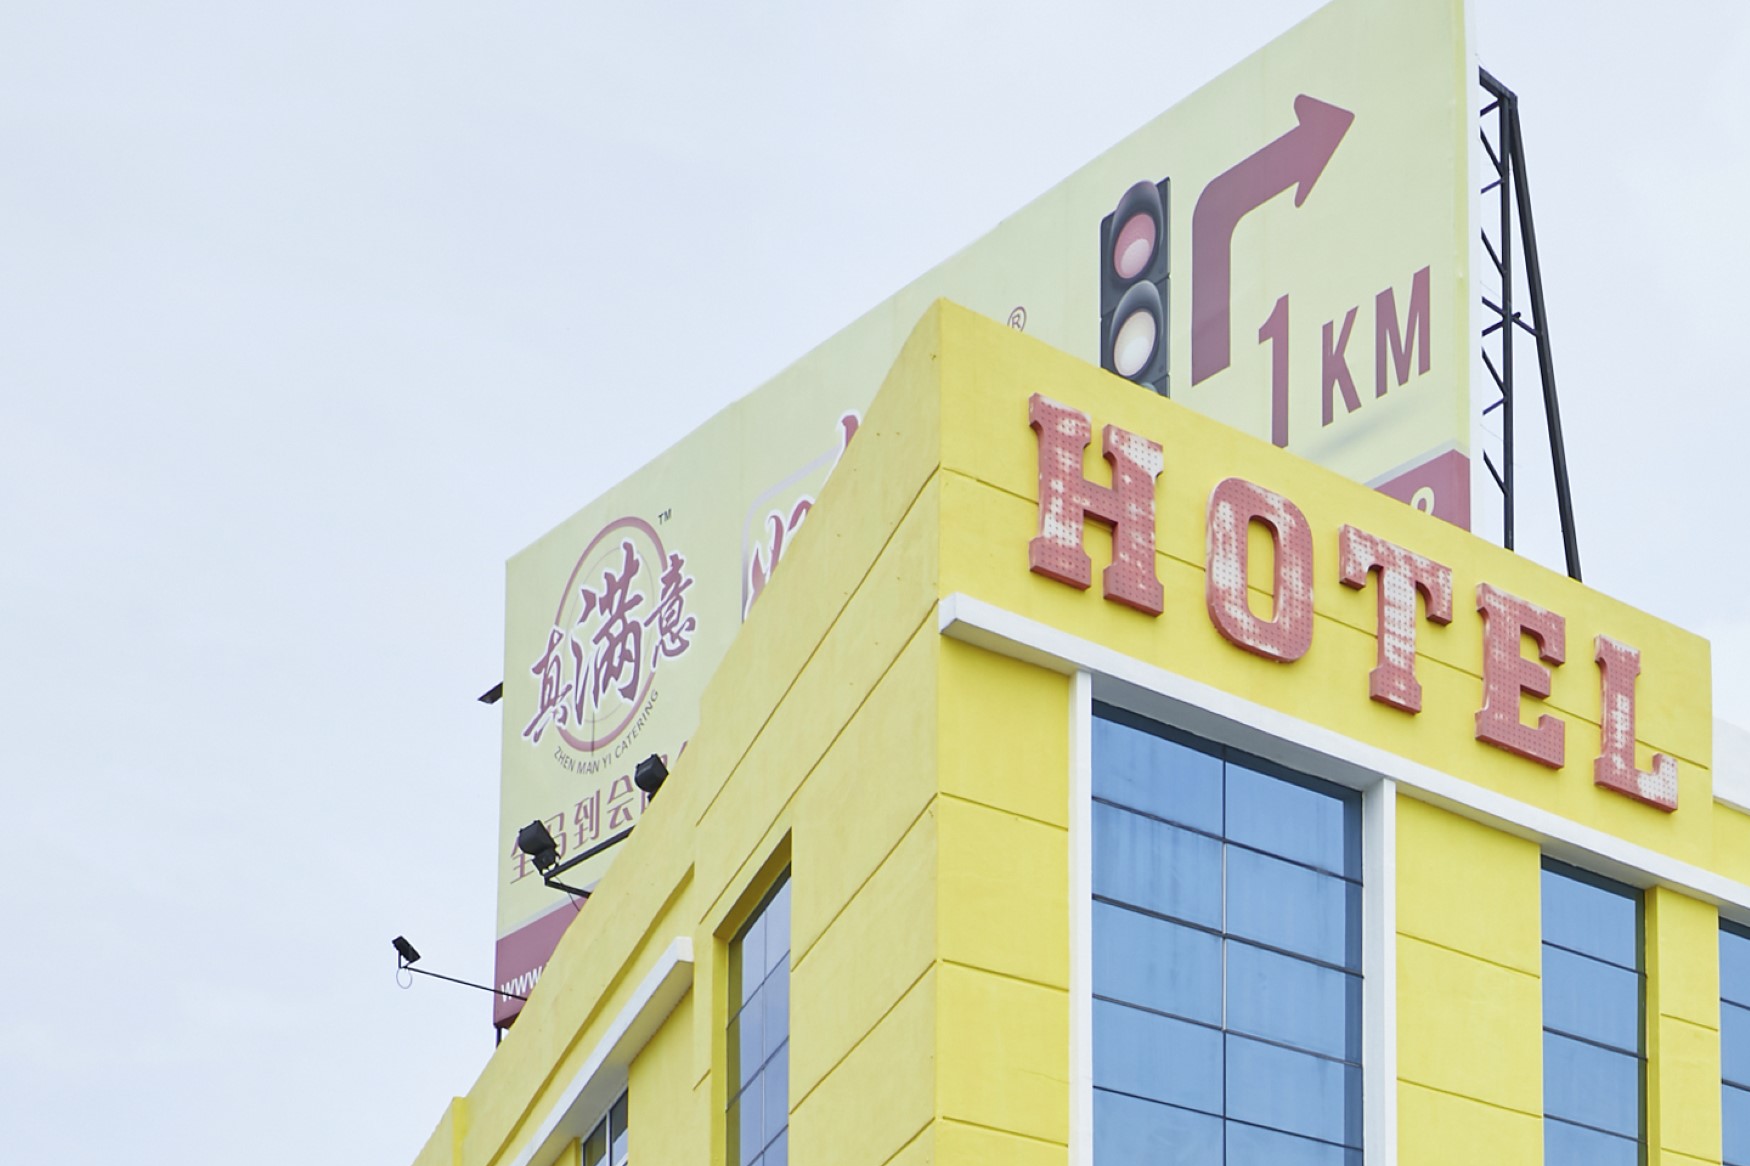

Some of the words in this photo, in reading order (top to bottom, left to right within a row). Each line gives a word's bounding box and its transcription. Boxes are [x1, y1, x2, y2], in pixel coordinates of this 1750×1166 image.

[1258, 293, 1290, 449] 1
[1322, 265, 1431, 428] KM
[1029, 392, 1678, 813] HOTEL
[554, 746, 576, 774] ZHEN
[576, 761, 600, 776] MAN
[602, 754, 612, 769] YI
[614, 689, 659, 760] CATERING
